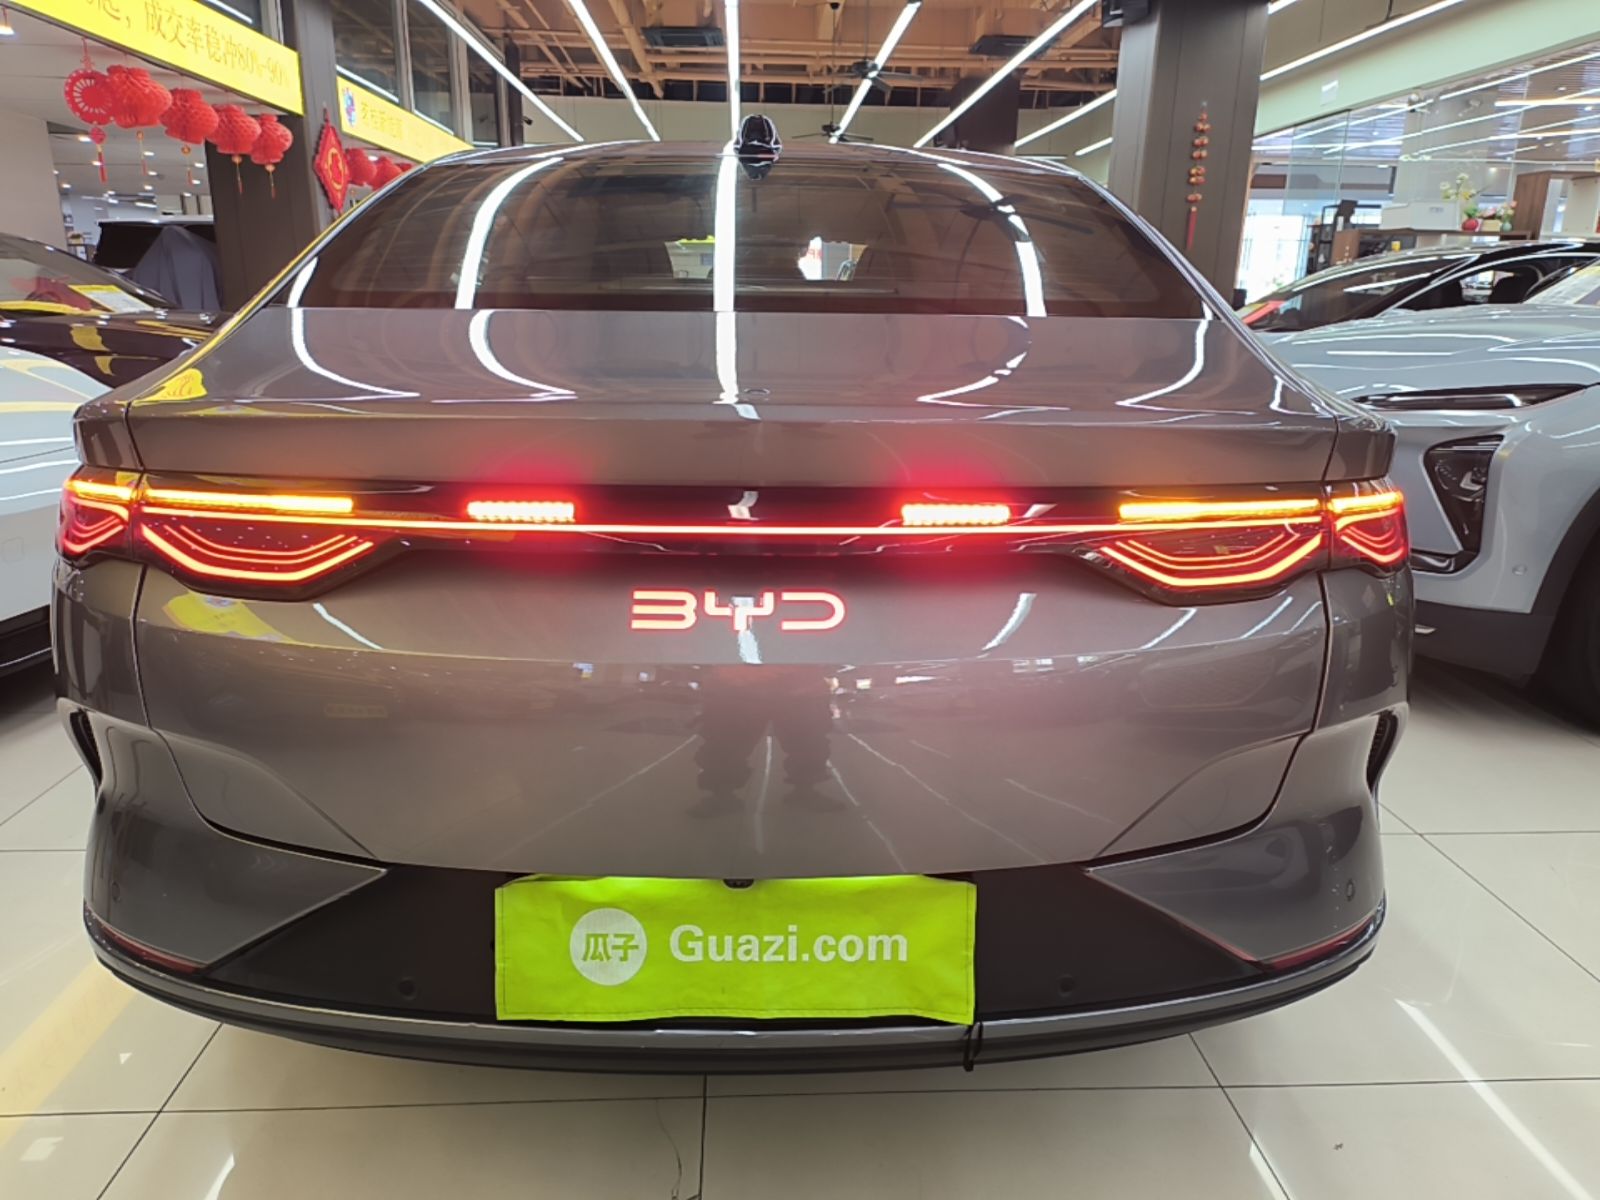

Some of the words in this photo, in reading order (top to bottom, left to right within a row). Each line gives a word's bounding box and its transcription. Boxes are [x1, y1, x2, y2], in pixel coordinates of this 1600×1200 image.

[630, 589, 847, 633] BYD
[582, 933, 640, 962] 瓜子
[669, 923, 908, 963] Guazi.com
